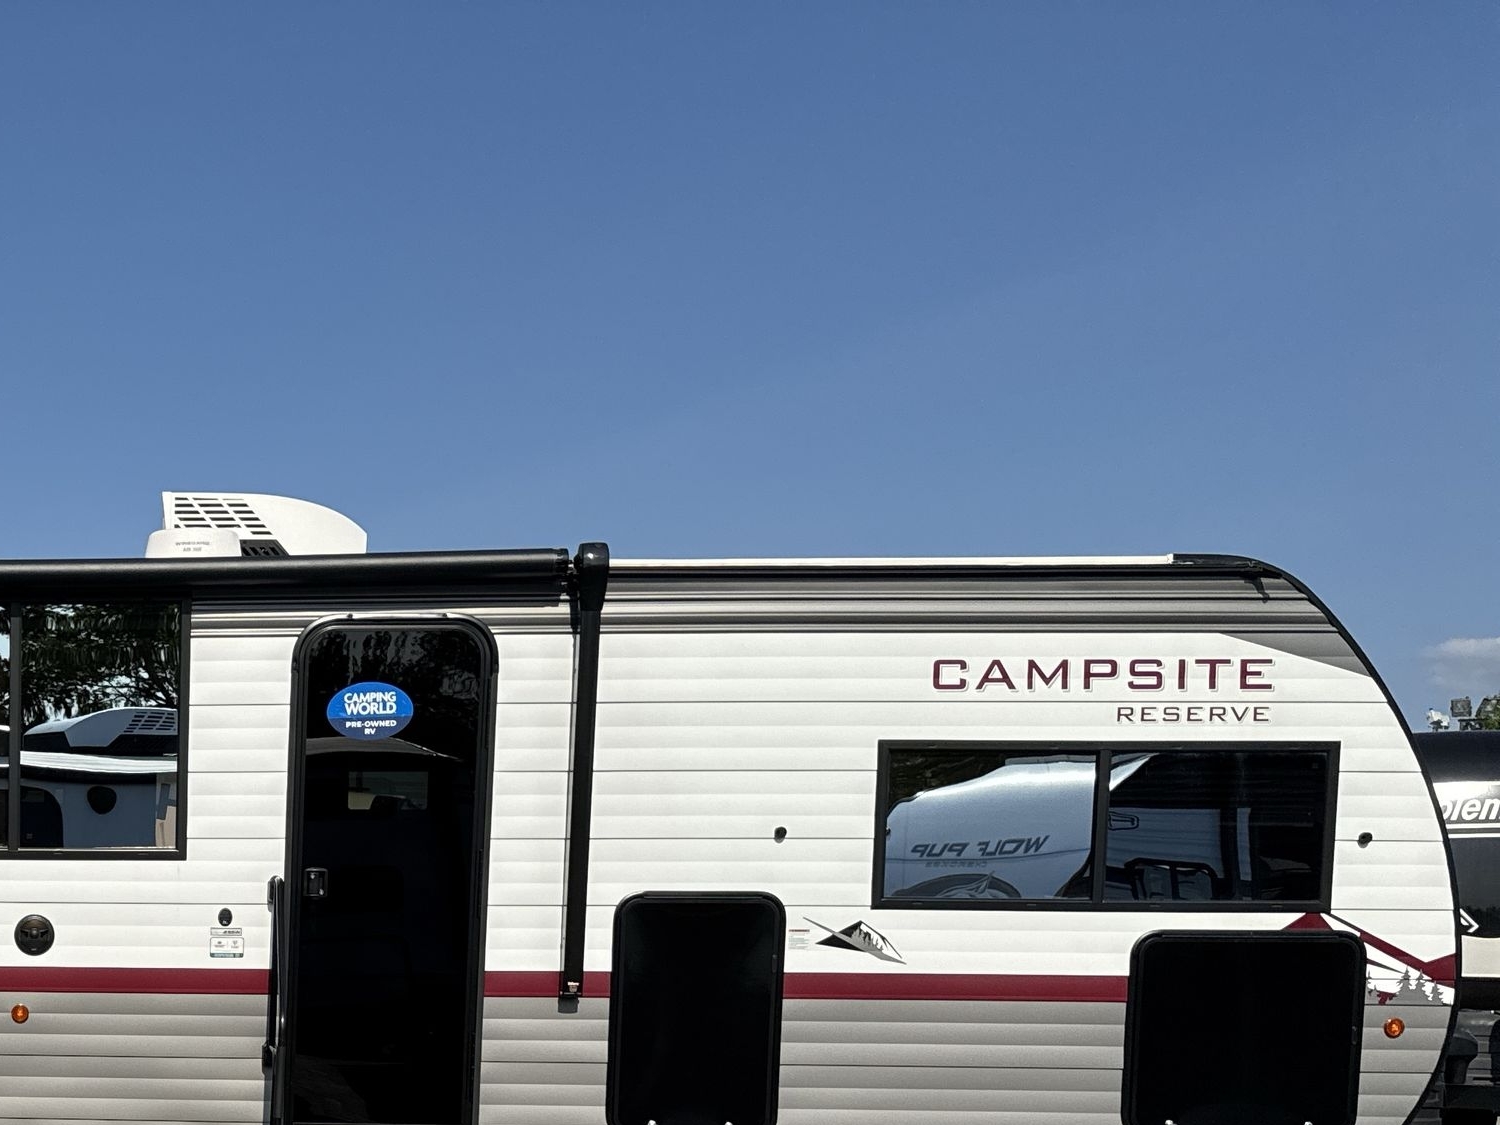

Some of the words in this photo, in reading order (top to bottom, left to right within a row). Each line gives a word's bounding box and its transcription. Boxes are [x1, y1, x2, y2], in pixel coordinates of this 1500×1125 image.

[932, 658, 1275, 692] CAMPSITE
[343, 691, 397, 703] CAMPING
[344, 702, 397, 715] WORLD
[1116, 706, 1270, 723] RESERVE
[345, 720, 397, 728] PRE-OWNED
